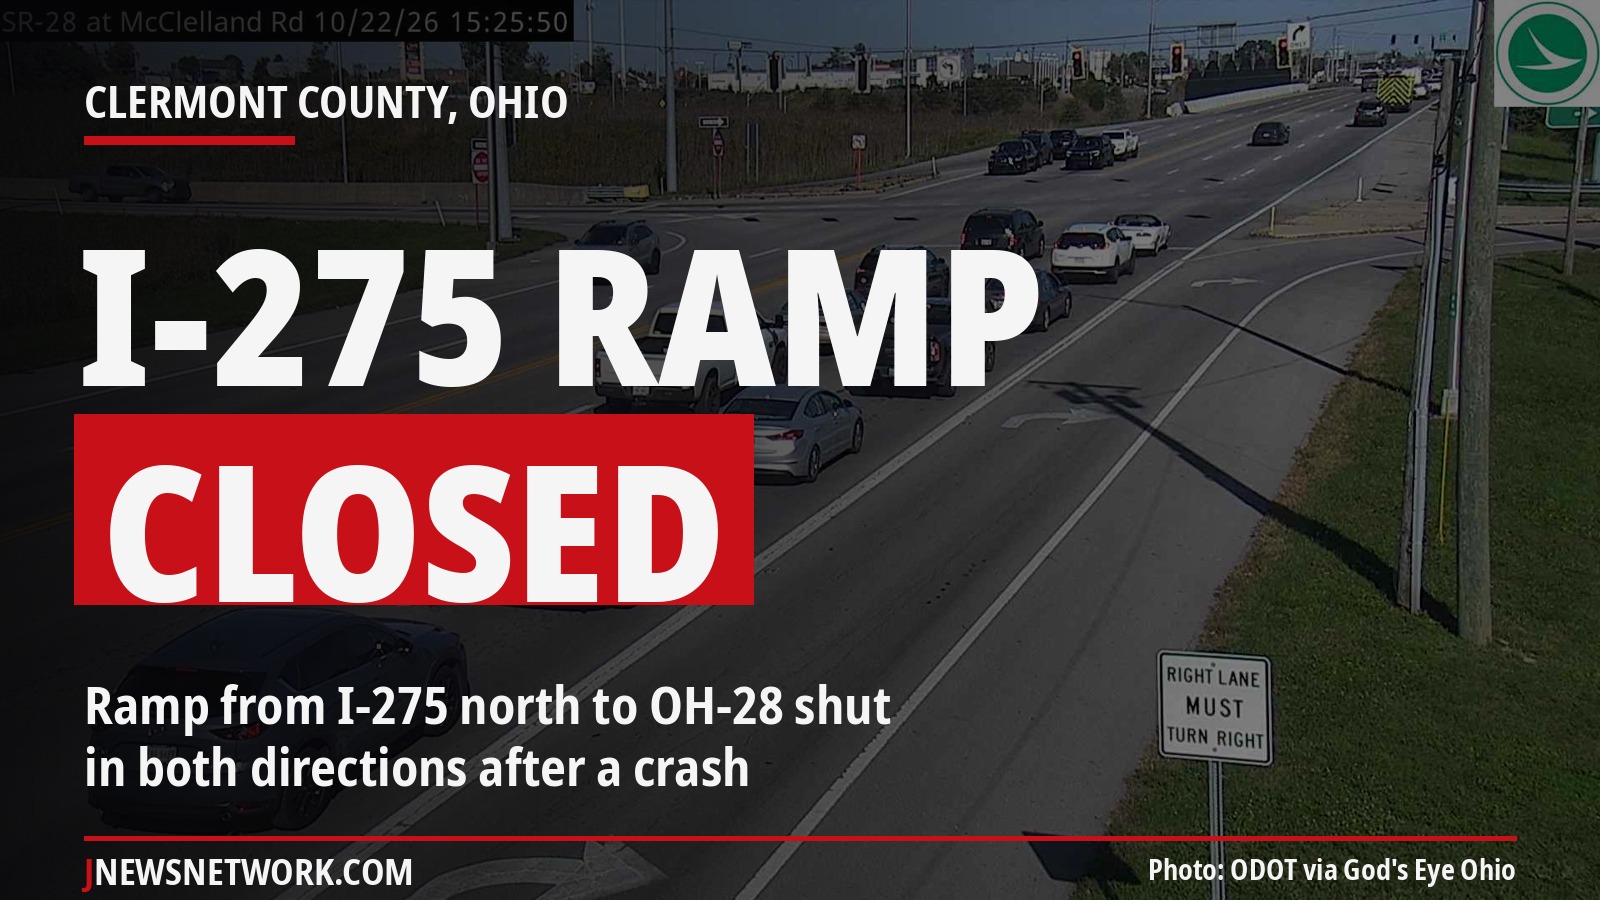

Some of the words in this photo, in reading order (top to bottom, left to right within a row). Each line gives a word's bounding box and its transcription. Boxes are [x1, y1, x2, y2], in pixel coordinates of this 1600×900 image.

[1167, 666, 1213, 684] RIGHT
[1217, 669, 1259, 687] LANE
[1186, 694, 1243, 718] MUST
[1167, 725, 1208, 744] TURN
[1216, 729, 1263, 748] RIGHT
